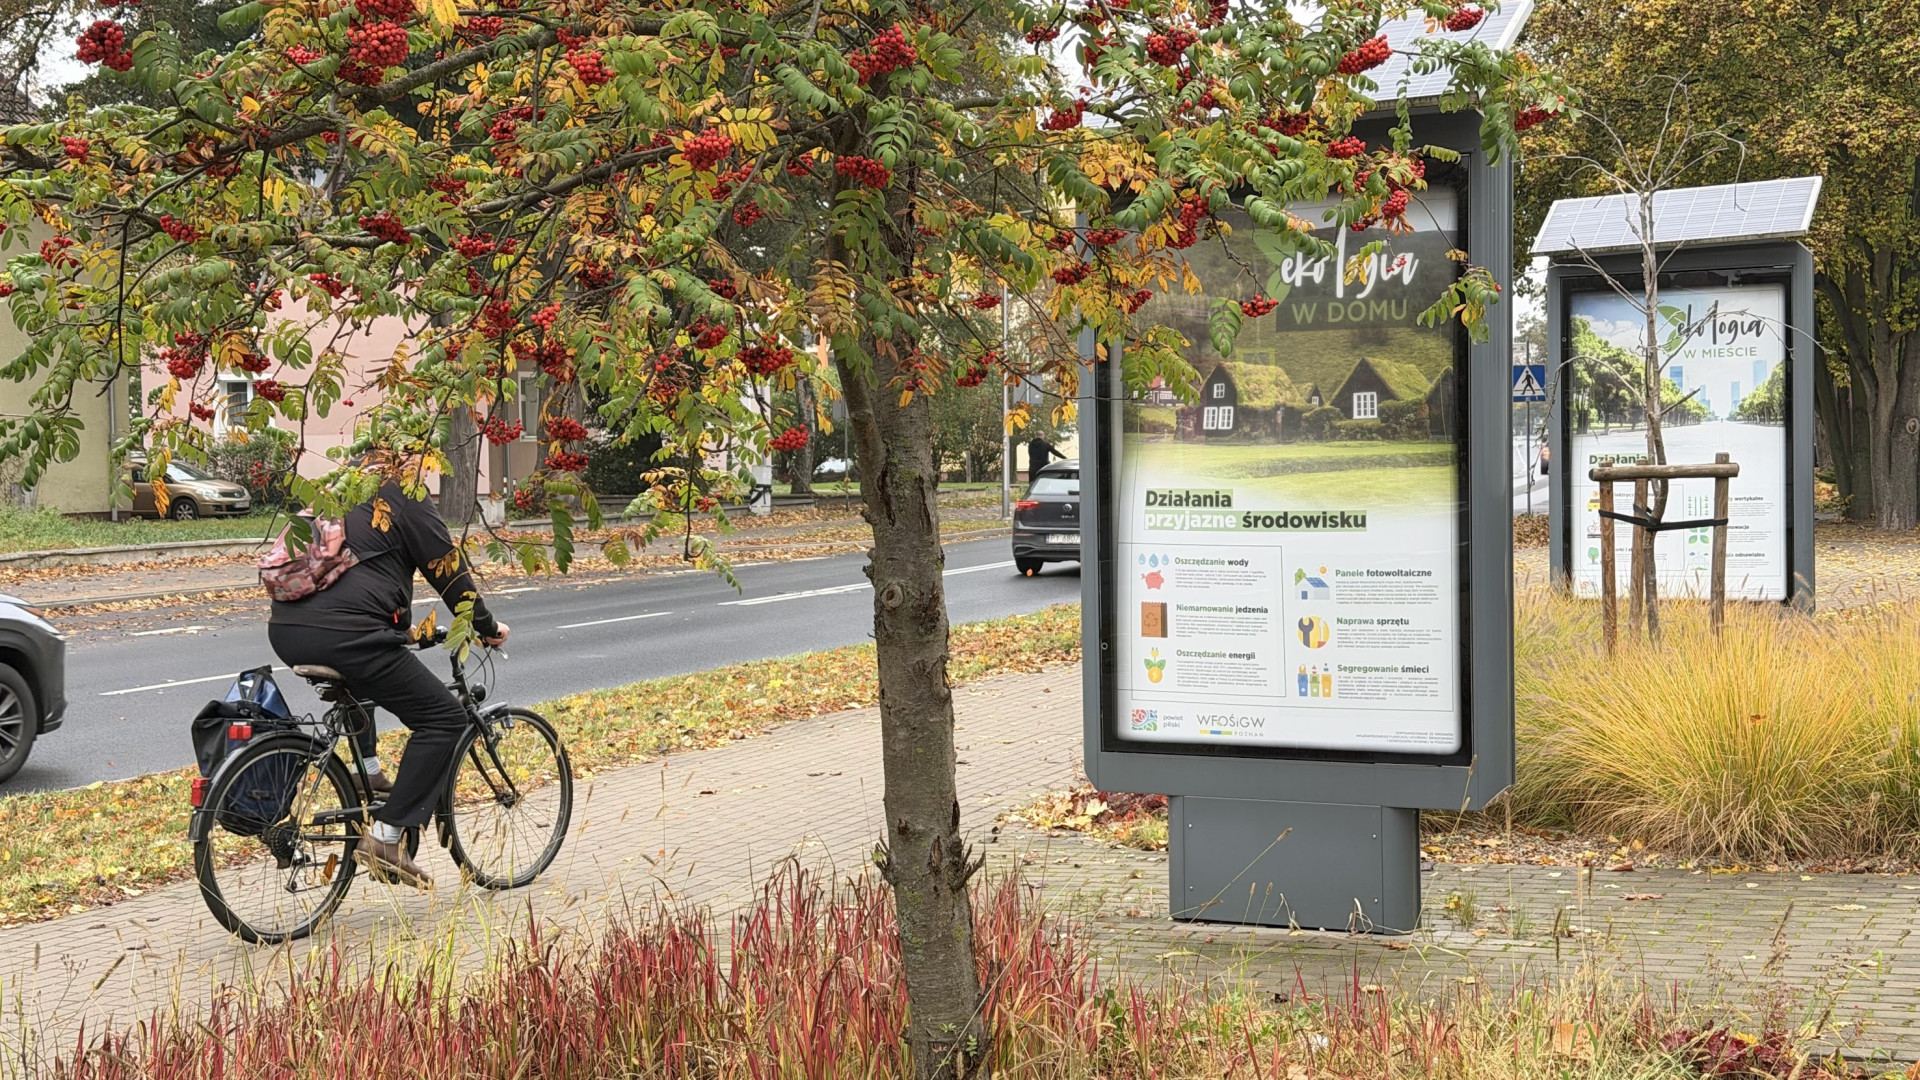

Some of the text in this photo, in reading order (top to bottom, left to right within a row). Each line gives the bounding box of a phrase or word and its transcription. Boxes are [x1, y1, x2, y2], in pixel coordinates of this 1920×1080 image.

[1291, 299, 1408, 325] W DOMU
[1683, 346, 1758, 359] W MIEŚCIE
[1145, 490, 1232, 507] Działania
[1145, 510, 1367, 530] przyjazne środowisku
[1174, 557, 1249, 567] Oszczędzanie wody
[1335, 568, 1432, 577] Panele fotowoltaiczne
[1176, 604, 1269, 615] Niemarnowanie jedzenia
[1336, 617, 1410, 627] Naprawa sprzętu
[1176, 650, 1256, 660] Oszczędzanie energii
[1337, 664, 1430, 674] Segregowanie śmieci
[1196, 714, 1266, 728] WFOŚiGW
